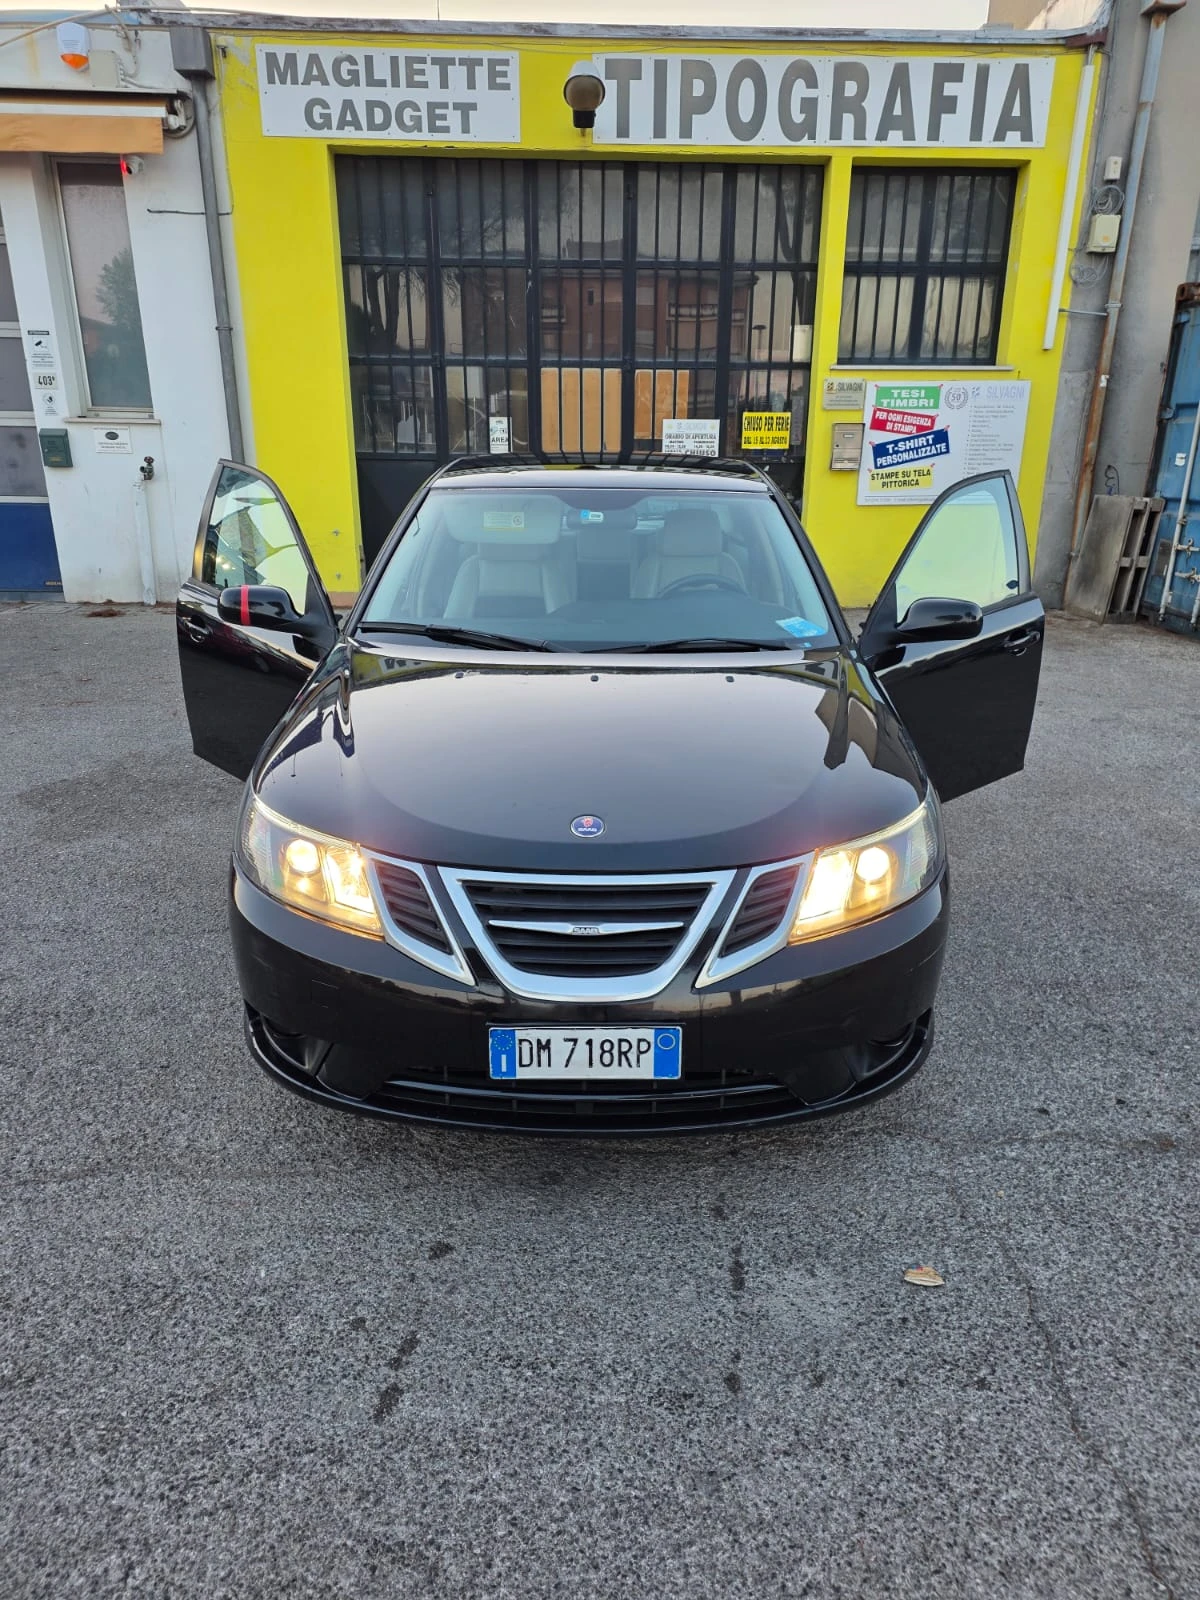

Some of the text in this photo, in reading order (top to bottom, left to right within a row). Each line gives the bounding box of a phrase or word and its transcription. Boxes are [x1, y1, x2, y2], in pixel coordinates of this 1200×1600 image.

[265, 52, 512, 91] MAGLIETTE
[604, 57, 1034, 143] TIPOGRAFIA
[304, 97, 478, 134] GADGET
[837, 382, 863, 392] SILVAGNI
[891, 389, 926, 398] TESI
[987, 385, 1025, 400] SILVAGNI
[881, 398, 934, 408] TIMBRI
[744, 415, 790, 431] CHIUSO PER FERIE
[875, 411, 932, 426] PER OGNI ESIGENZA
[886, 421, 917, 434] DI STAMPA
[664, 432, 685, 440] ORARIO
[691, 432, 717, 440] APERTURA
[886, 434, 935, 454] T-SHIRT
[684, 449, 716, 457] CHIUSO
[876, 443, 947, 468] PERSONALIZZATE
[871, 469, 931, 481] STAMPE SU TELA
[881, 479, 920, 489] PITTORICA
[572, 926, 600, 935] SAAB
[501, 1038, 652, 1073] I DM 718RP
